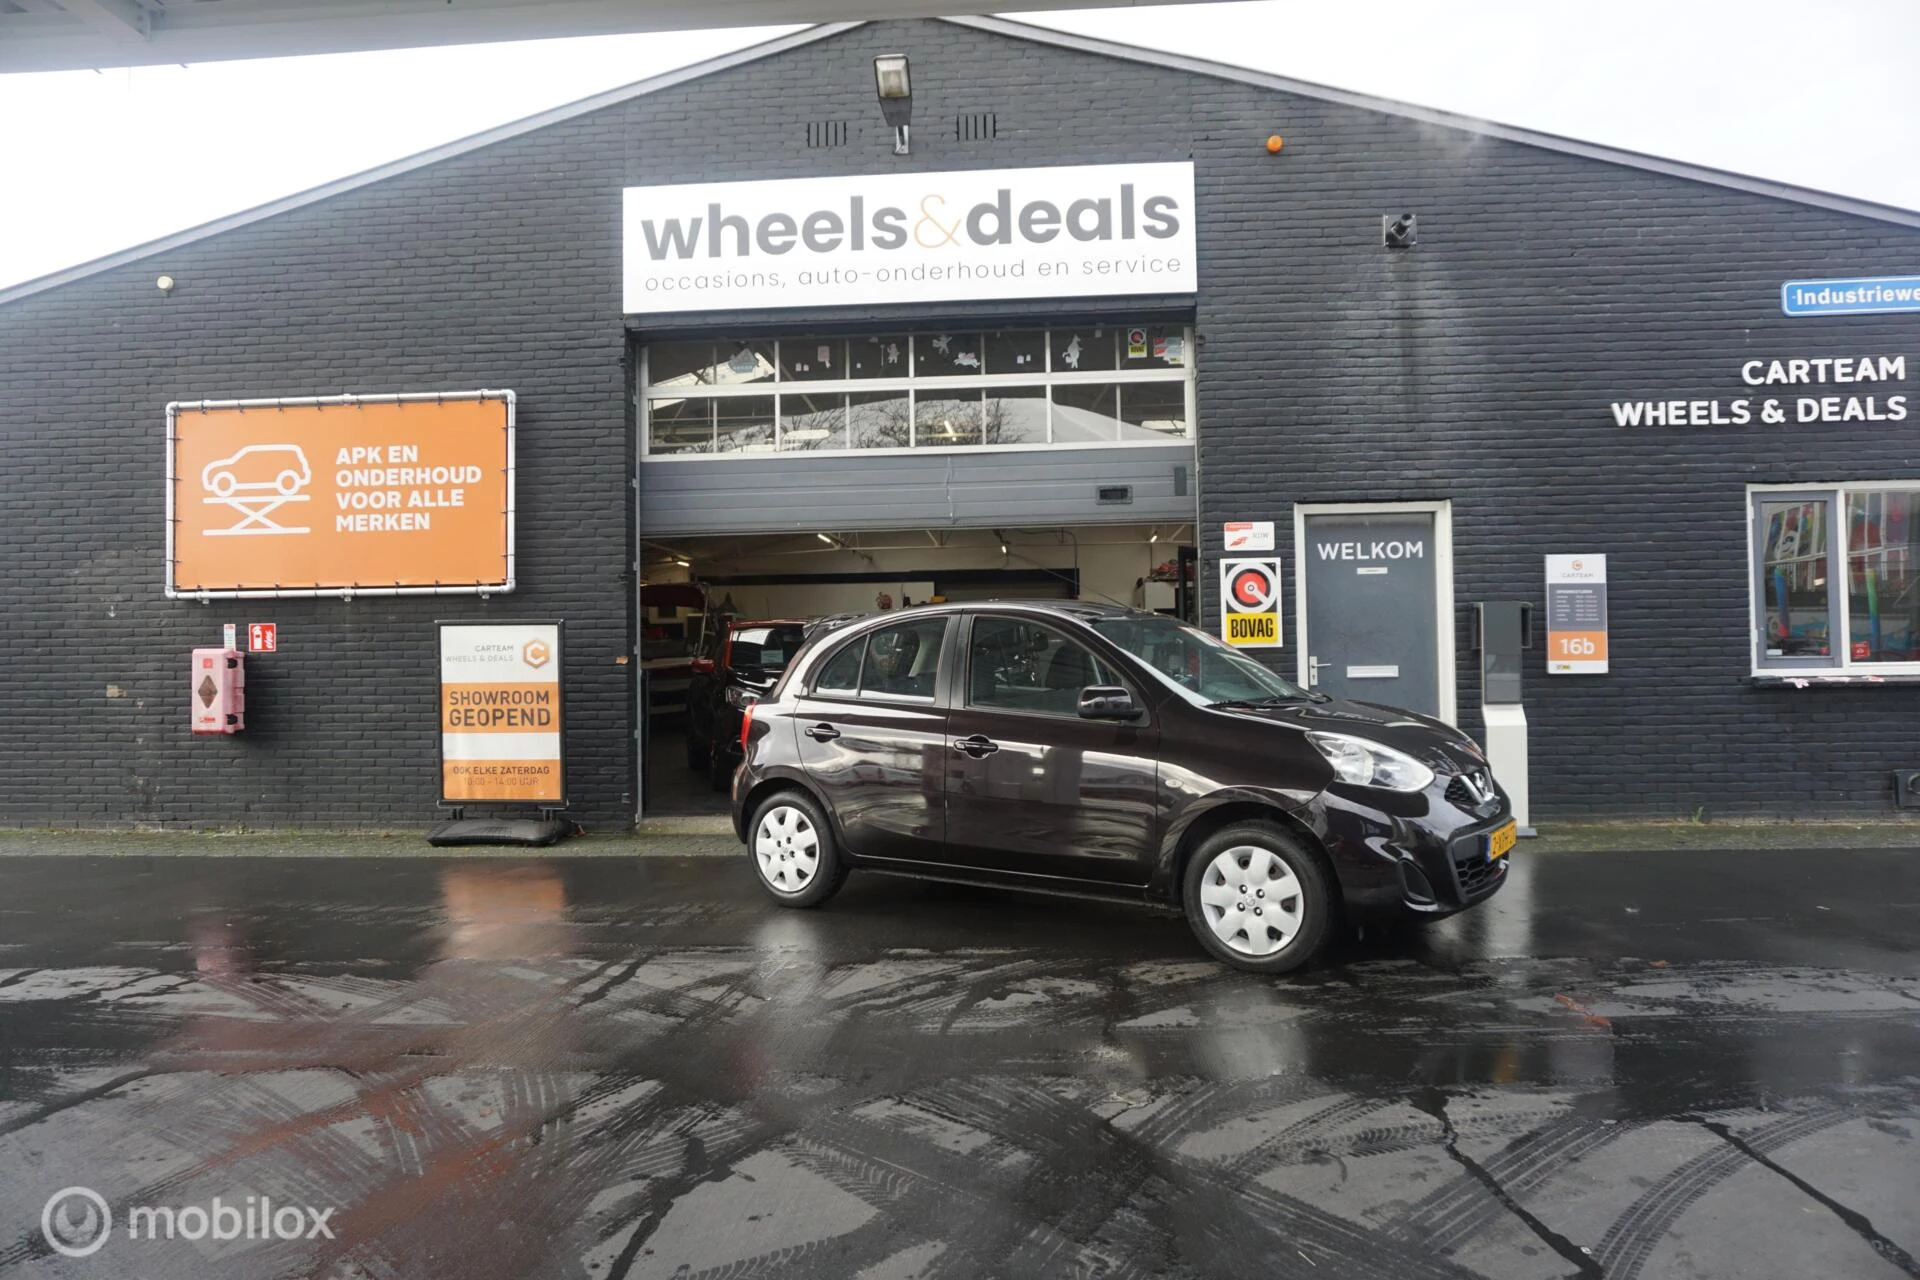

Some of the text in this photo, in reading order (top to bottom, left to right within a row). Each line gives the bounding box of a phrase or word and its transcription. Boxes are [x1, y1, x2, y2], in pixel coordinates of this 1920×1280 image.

[645, 254, 1181, 292] occasions, auto-onderhoud en service
[1741, 356, 1906, 386] CARTEAM
[1611, 396, 1907, 427] WHEELS & DEALS
[335, 444, 418, 465] APK EN
[335, 465, 482, 488] ONDERHOUD
[335, 488, 465, 510] VOOR ALLE
[335, 512, 430, 532] MERKEN
[1317, 541, 1424, 561] WELKOM
[1231, 617, 1274, 638] BOVAG
[475, 645, 514, 653] CARTEAM
[1560, 636, 1596, 655] 16b
[445, 655, 477, 663] WHEELS
[487, 654, 514, 662] DEALS
[449, 690, 550, 706] SHOWROOM
[449, 708, 551, 727] GEOPEND
[453, 766, 550, 775] OOK ELKE ZATERDAG
